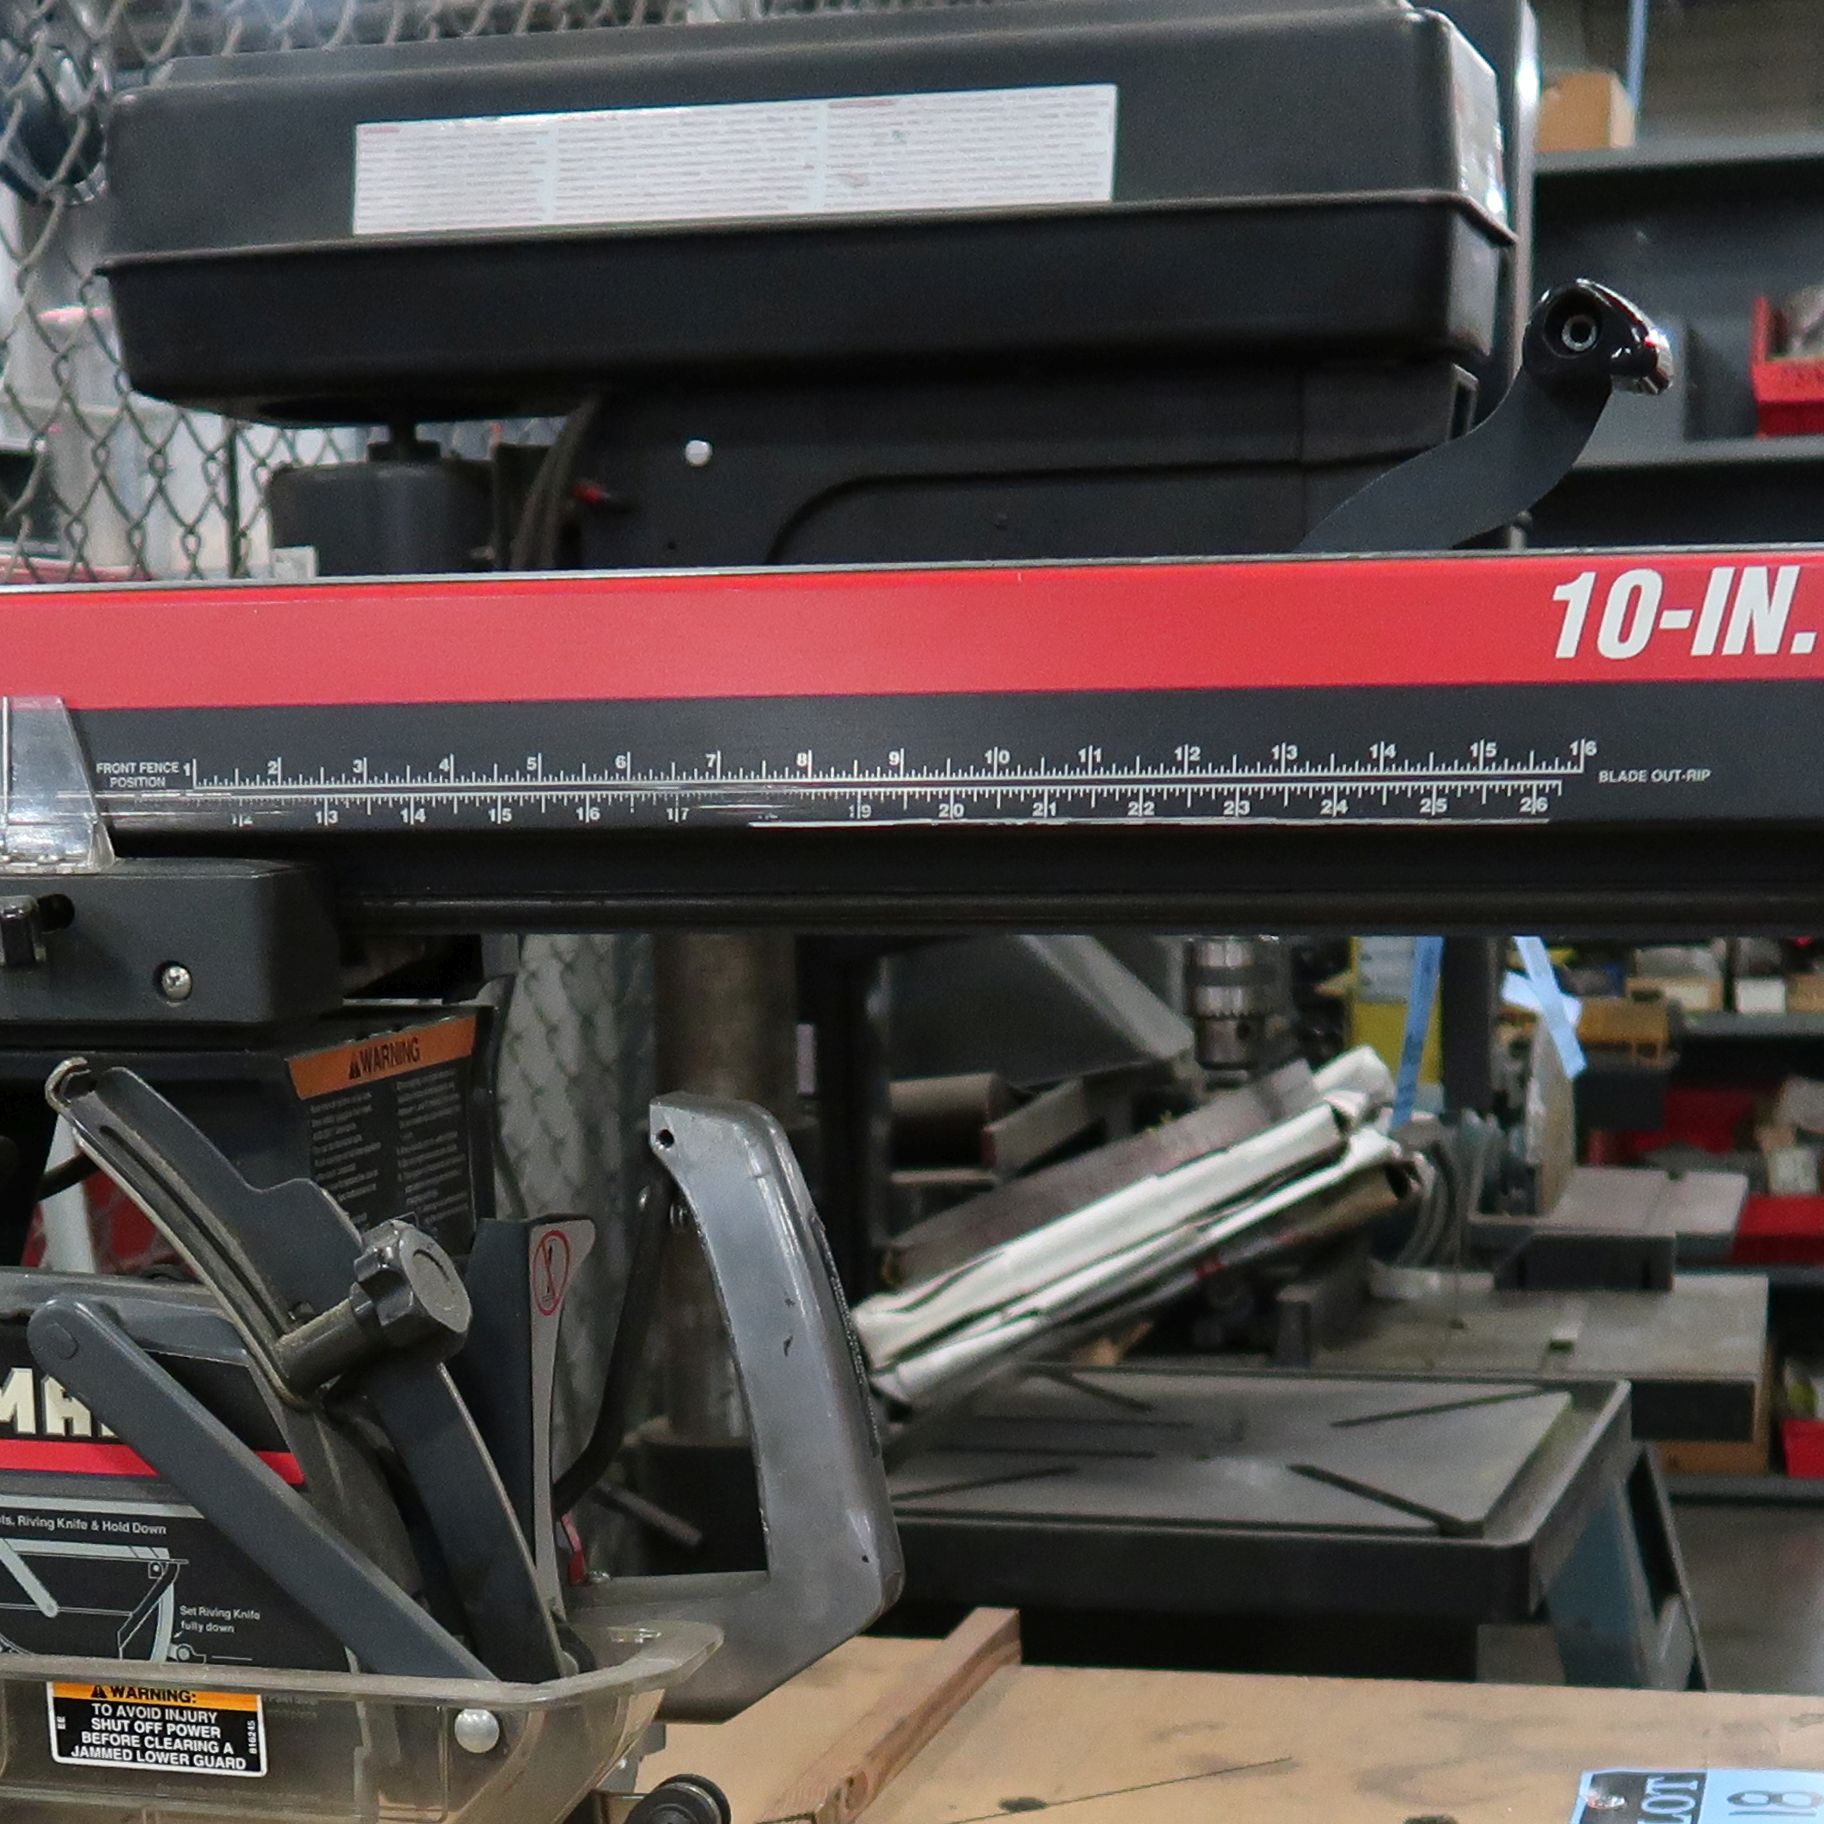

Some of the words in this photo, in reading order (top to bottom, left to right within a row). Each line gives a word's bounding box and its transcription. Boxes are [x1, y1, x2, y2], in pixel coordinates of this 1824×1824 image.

[1551, 564, 1818, 660] 10-IN.
[95, 761, 137, 775] FRONT
[139, 761, 180, 774] FENCE
[183, 762, 191, 777] 1
[267, 760, 278, 775] 2
[352, 758, 364, 774] 3
[438, 757, 450, 772] 4
[527, 756, 538, 771] 5
[615, 755, 627, 770] 6
[705, 753, 717, 768] 7
[796, 752, 808, 767] 8
[888, 751, 900, 766] 9
[984, 749, 1010, 765] 10
[1078, 747, 1103, 763] 11
[1174, 746, 1201, 761] 12
[1271, 744, 1298, 760] 13
[1369, 743, 1397, 759] 14
[1470, 741, 1498, 758] 15
[1569, 740, 1597, 756] 16
[109, 776, 166, 788] POSITION
[1598, 769, 1647, 783] BLADE
[1650, 768, 1712, 783] OUT-RIP
[315, 810, 339, 824] 13
[400, 808, 426, 823] 14
[488, 807, 513, 822] 15
[575, 806, 601, 821] 16
[666, 806, 689, 821] 17
[938, 803, 964, 818] 20
[1032, 802, 1057, 817] 21
[1127, 801, 1155, 816] 22
[1223, 801, 1251, 815] 23
[1319, 799, 1349, 815] 24
[1419, 798, 1448, 813] 25
[1519, 797, 1548, 813] 26
[359, 1036, 421, 1074] WARNING
[17, 1515, 55, 1531] Riving
[56, 1518, 88, 1530] Knife
[90, 1520, 100, 1531] &
[102, 1521, 130, 1533] Hold
[132, 1522, 167, 1535] Down
[179, 1605, 197, 1616] Set
[198, 1606, 232, 1620] Riving
[233, 1608, 261, 1620] Knife
[181, 1620, 204, 1633] fully
[205, 1622, 235, 1633] down
[109, 1685, 197, 1704] WARNING:
[91, 1702, 113, 1716] TO
[116, 1705, 162, 1720] AVOID
[165, 1709, 218, 1724] INJURY
[91, 1717, 130, 1732] SHUT
[134, 1720, 163, 1735] OFF
[166, 1723, 222, 1739] POWER
[81, 1731, 141, 1747] BEFORE
[144, 1736, 219, 1754] CLEARING
[222, 1742, 235, 1755] A
[71, 1745, 134, 1762] JAMMED
[136, 1750, 190, 1766] LOWER
[193, 1755, 247, 1770] GUARD
